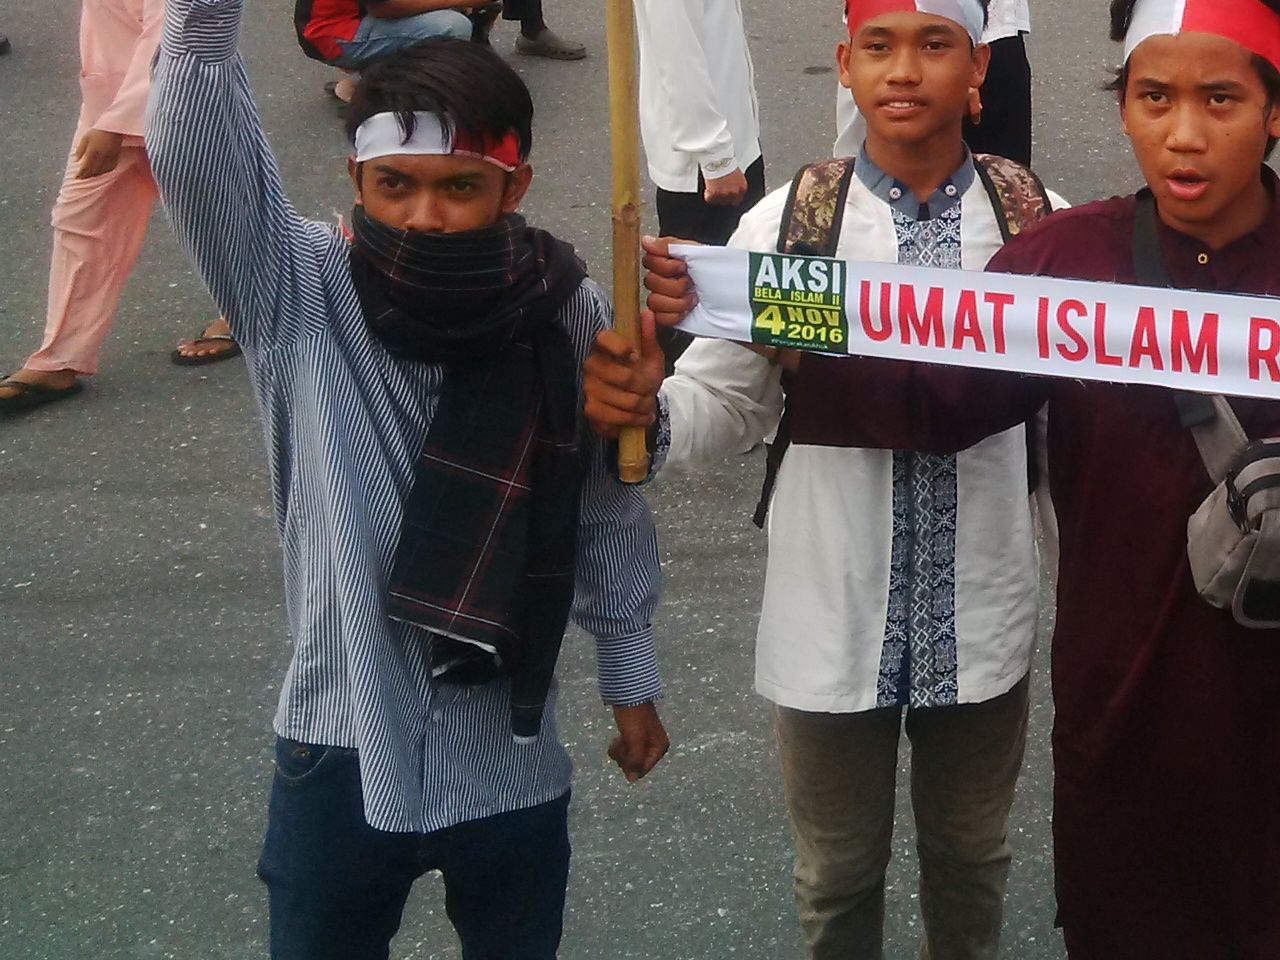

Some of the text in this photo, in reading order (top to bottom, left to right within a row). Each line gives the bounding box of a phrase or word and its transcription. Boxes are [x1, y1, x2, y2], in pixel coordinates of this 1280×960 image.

[755, 256, 840, 294] AKSI
[754, 287, 781, 300] BELA
[790, 291, 823, 304] ISLAM
[755, 305, 839, 335] 4 NOV
[787, 324, 843, 343] 2016
[859, 280, 1014, 354] UMAT
[1036, 296, 1219, 376] ISLAM
